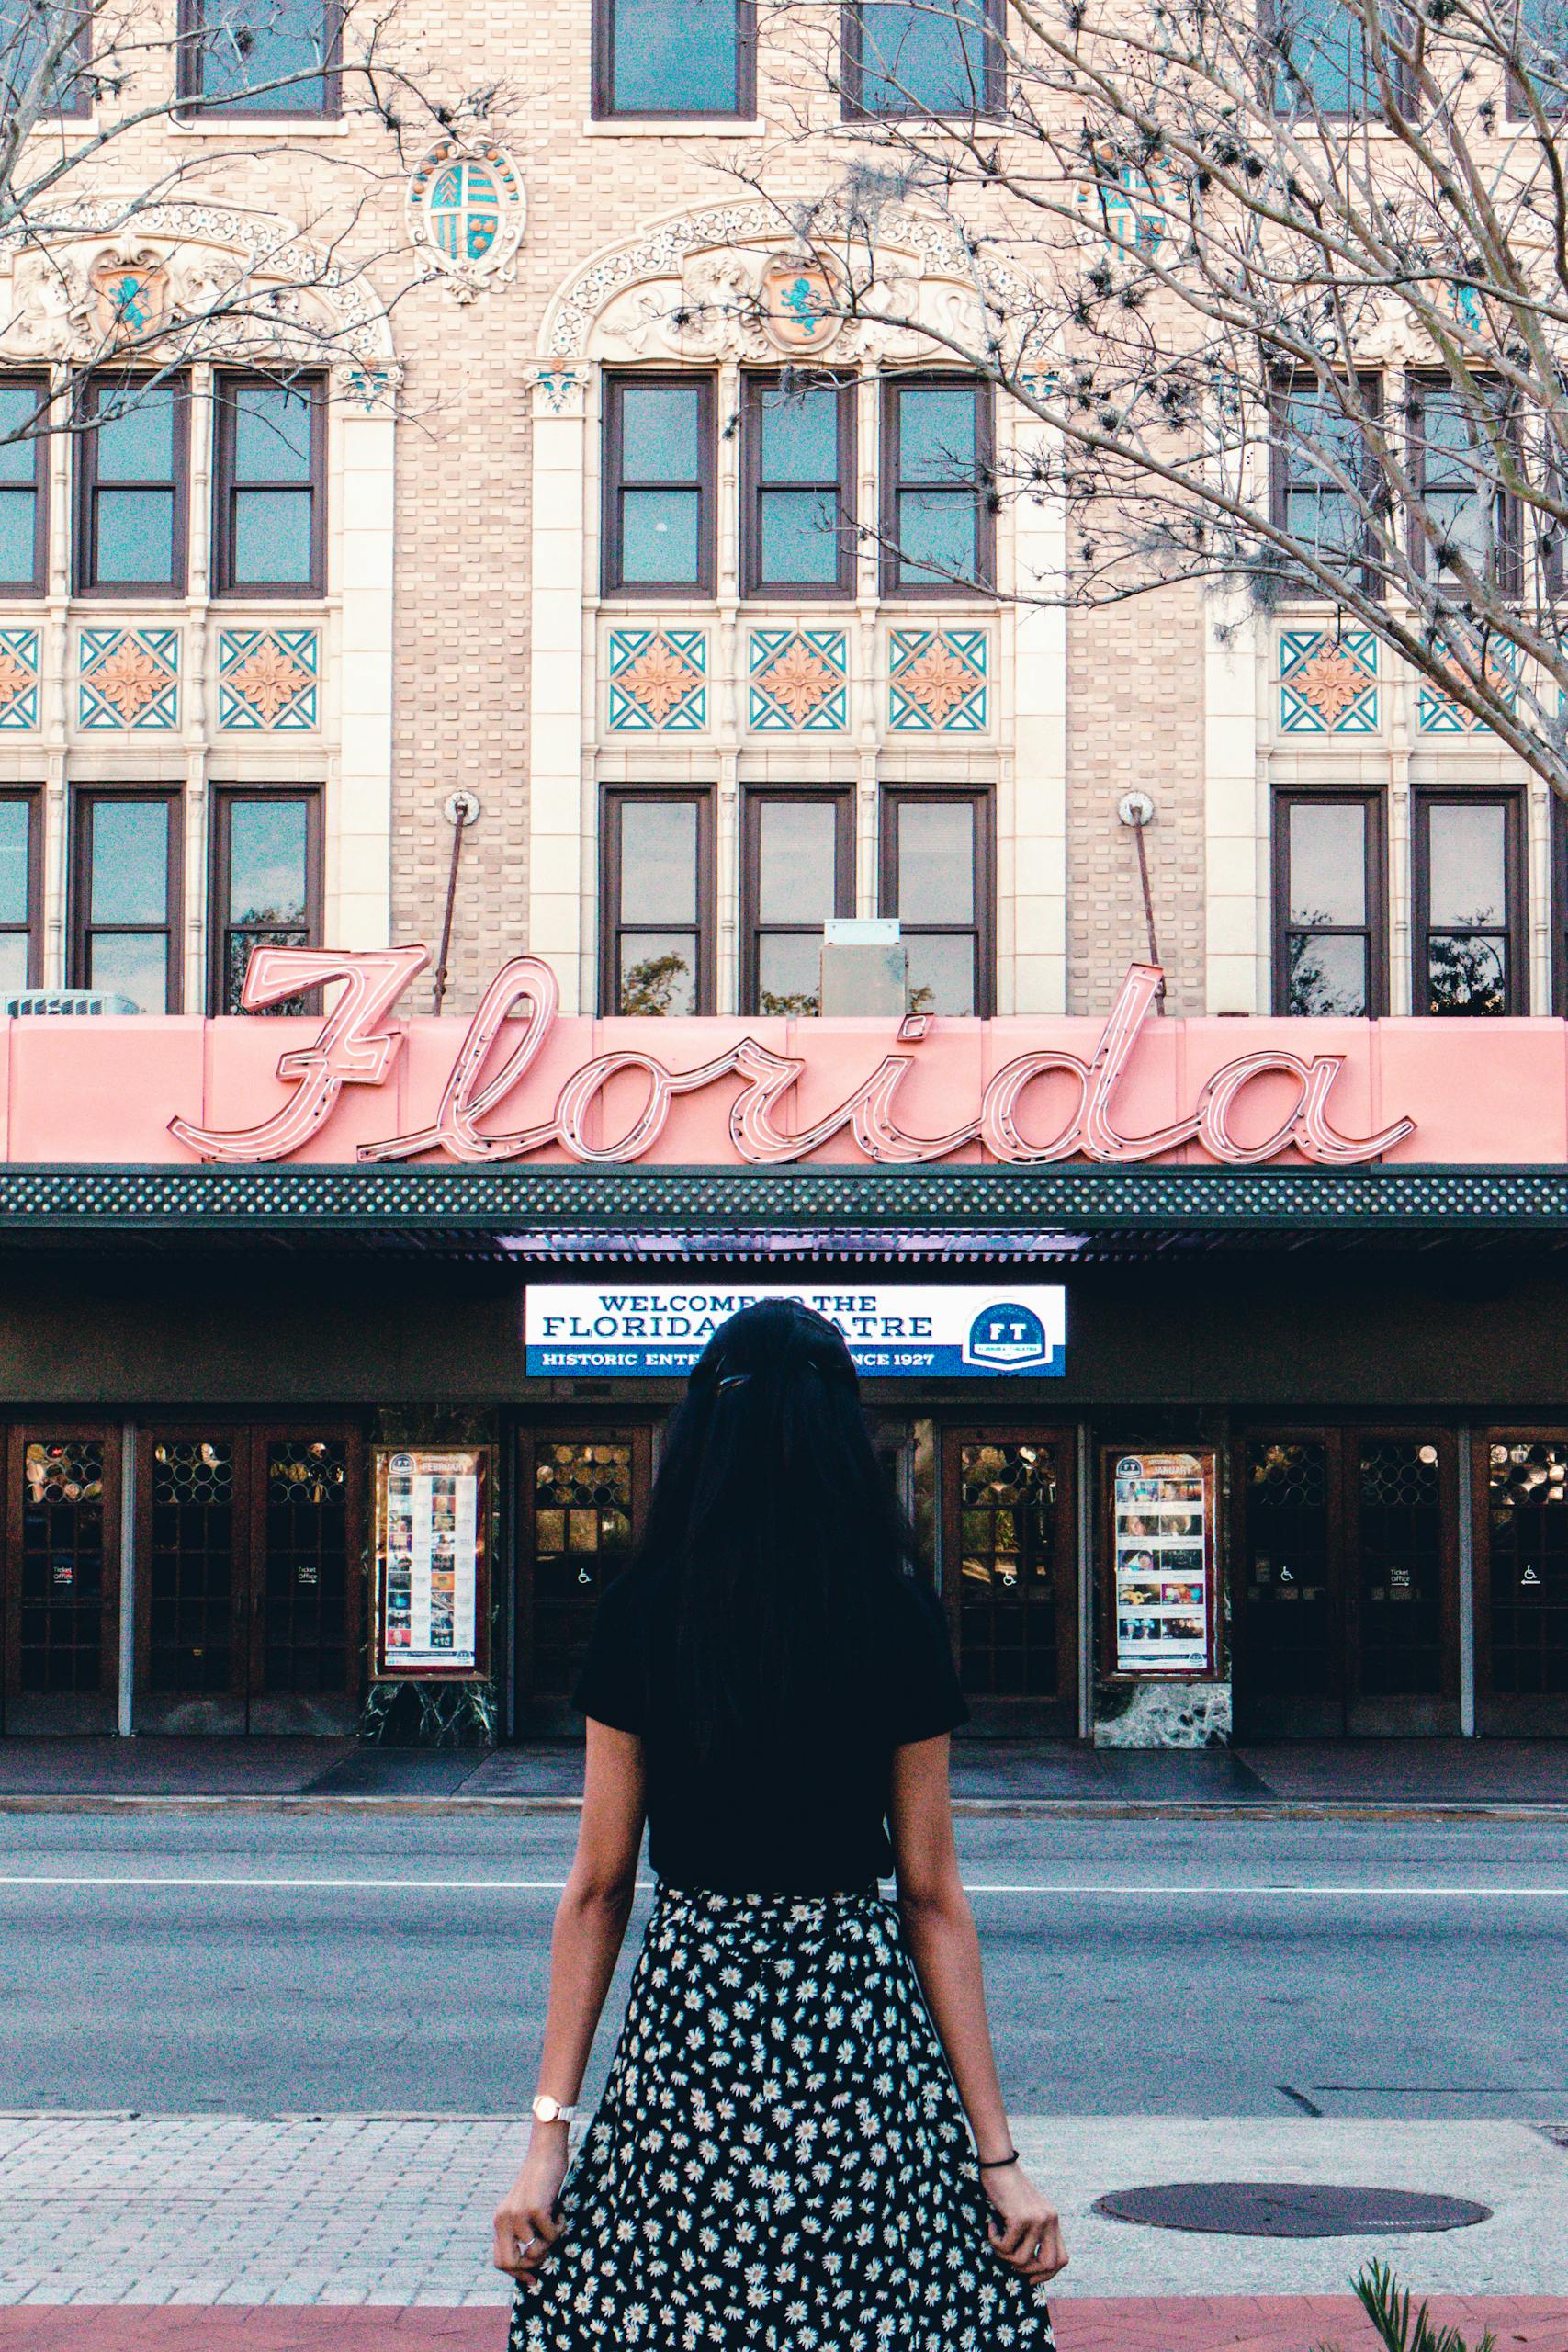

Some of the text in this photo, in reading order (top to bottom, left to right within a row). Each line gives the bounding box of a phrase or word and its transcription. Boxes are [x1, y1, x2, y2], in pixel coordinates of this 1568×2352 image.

[166, 944, 1418, 1162] Florida
[599, 1296, 755, 1311] WELCOME
[813, 1296, 877, 1312] THE
[543, 1316, 716, 1337] FLORIDA
[542, 1353, 637, 1366] HISTORIC
[893, 1353, 935, 1366] 1927
